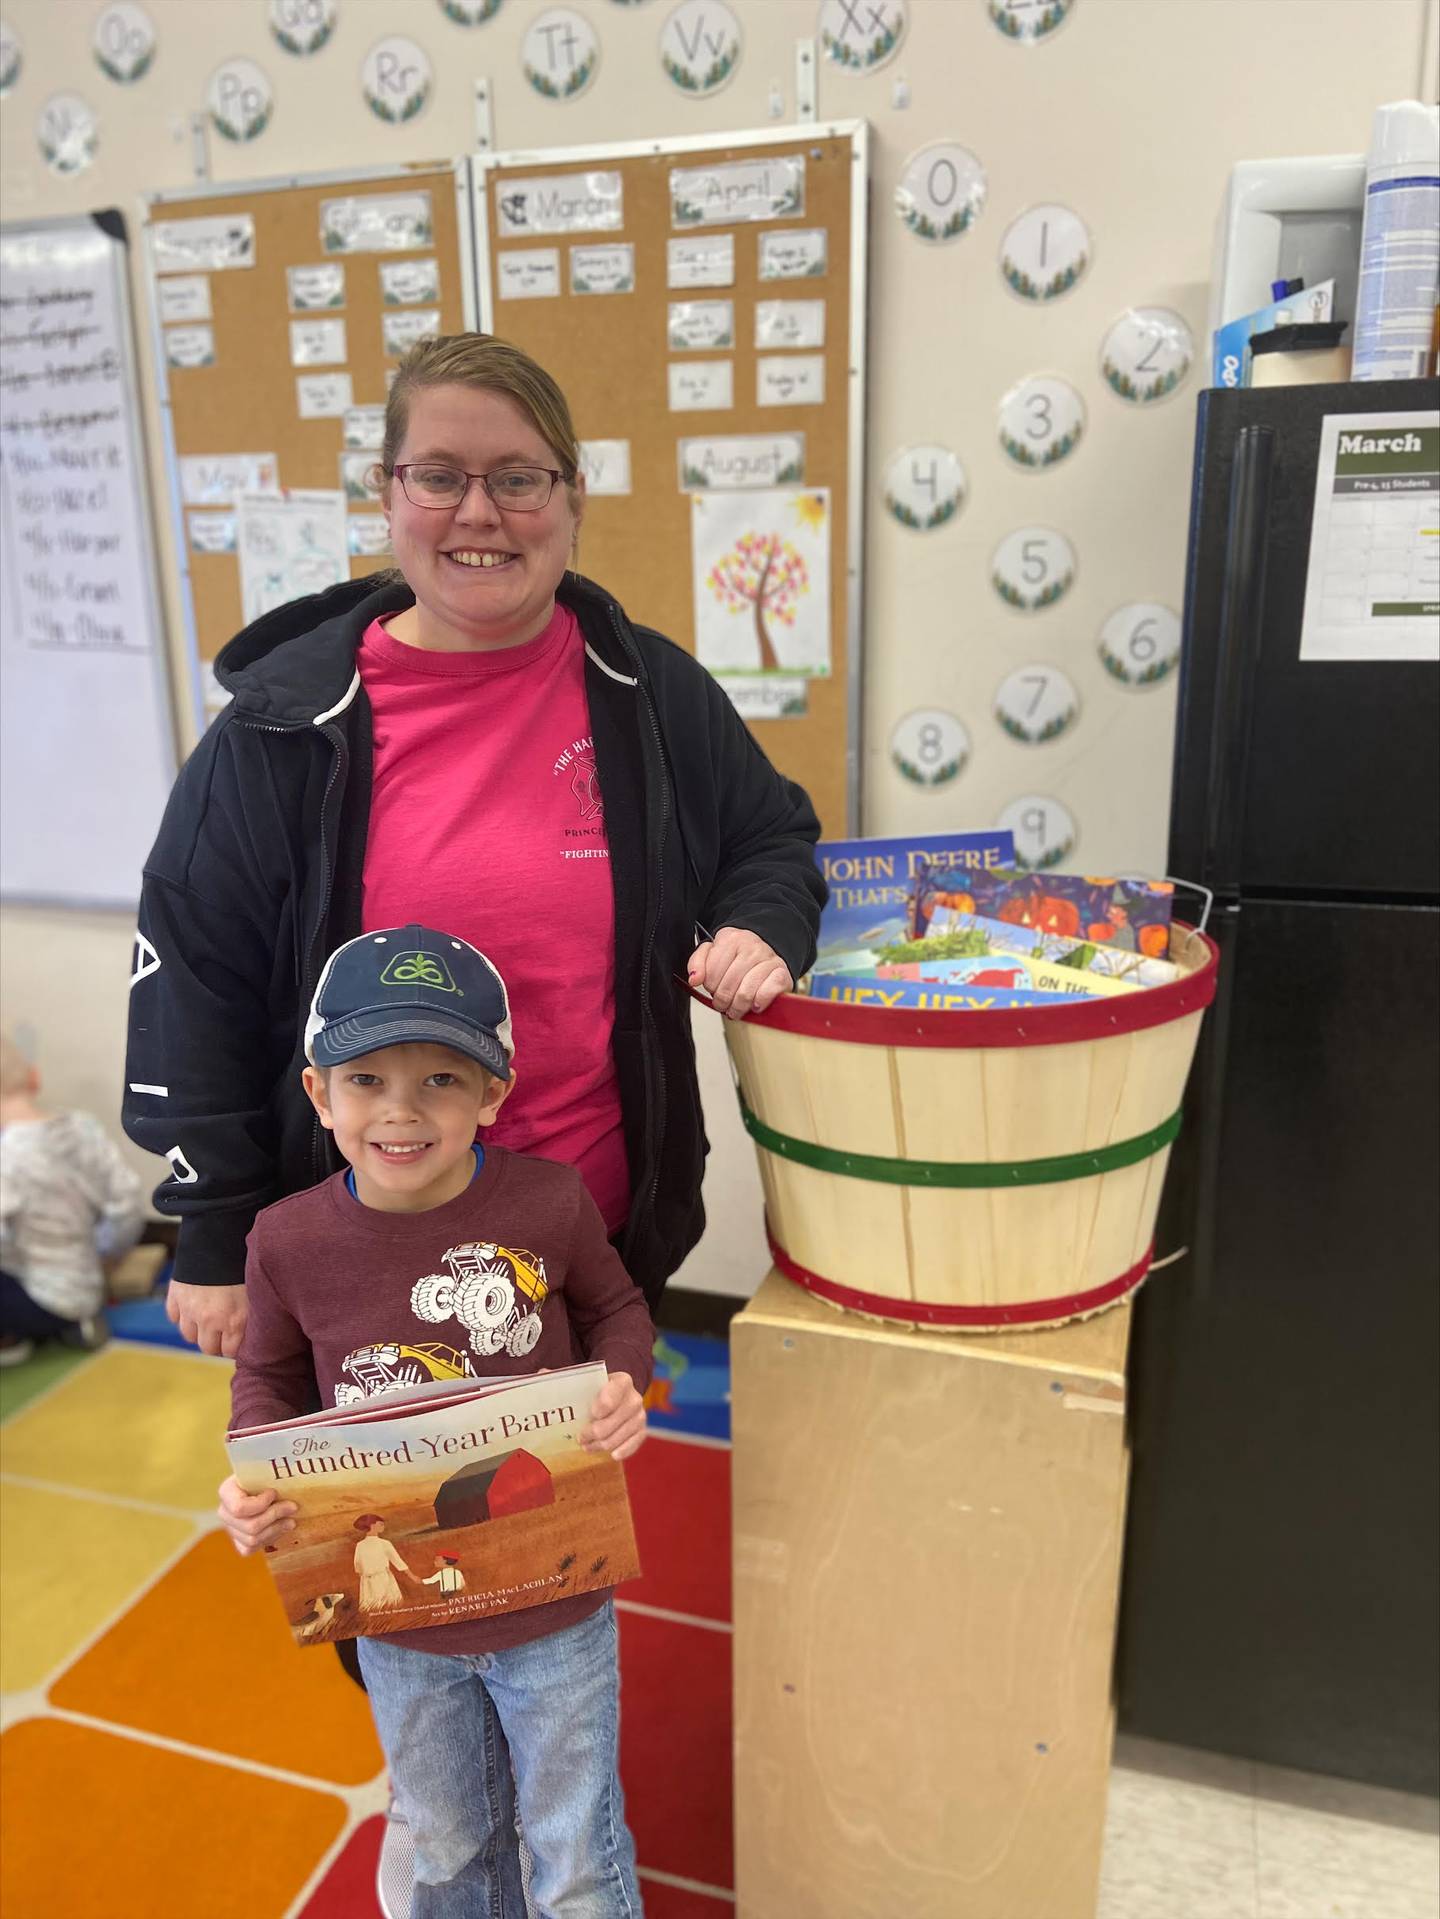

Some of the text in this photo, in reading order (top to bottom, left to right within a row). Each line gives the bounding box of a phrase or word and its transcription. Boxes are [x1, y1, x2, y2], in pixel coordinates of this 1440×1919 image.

[538, 22, 580, 71] Tt
[674, 14, 726, 61] Vv
[375, 50, 419, 95] Rr
[705, 170, 770, 212] April
[927, 158, 957, 206] 0
[1039, 221, 1049, 269] 1
[1133, 328, 1166, 373] 2
[1025, 393, 1053, 440] 3
[702, 445, 782, 481] August
[1339, 432, 1422, 455] March
[911, 460, 938, 502] 4
[1392, 478, 1430, 489] Students
[1021, 539, 1048, 584] 5
[1128, 618, 1159, 662] 6
[1021, 675, 1048, 717] 7
[917, 723, 944, 765] 8
[1021, 808, 1047, 848] 9
[822, 847, 1000, 882] JOHN DEERE
[1039, 975, 1060, 990] ON
[268, 1404, 577, 1480] Hundred-Year Barn
[292, 1437, 331, 1457] The
[448, 1591, 495, 1607] PATRICIA
[489, 1597, 509, 1608] PAK
